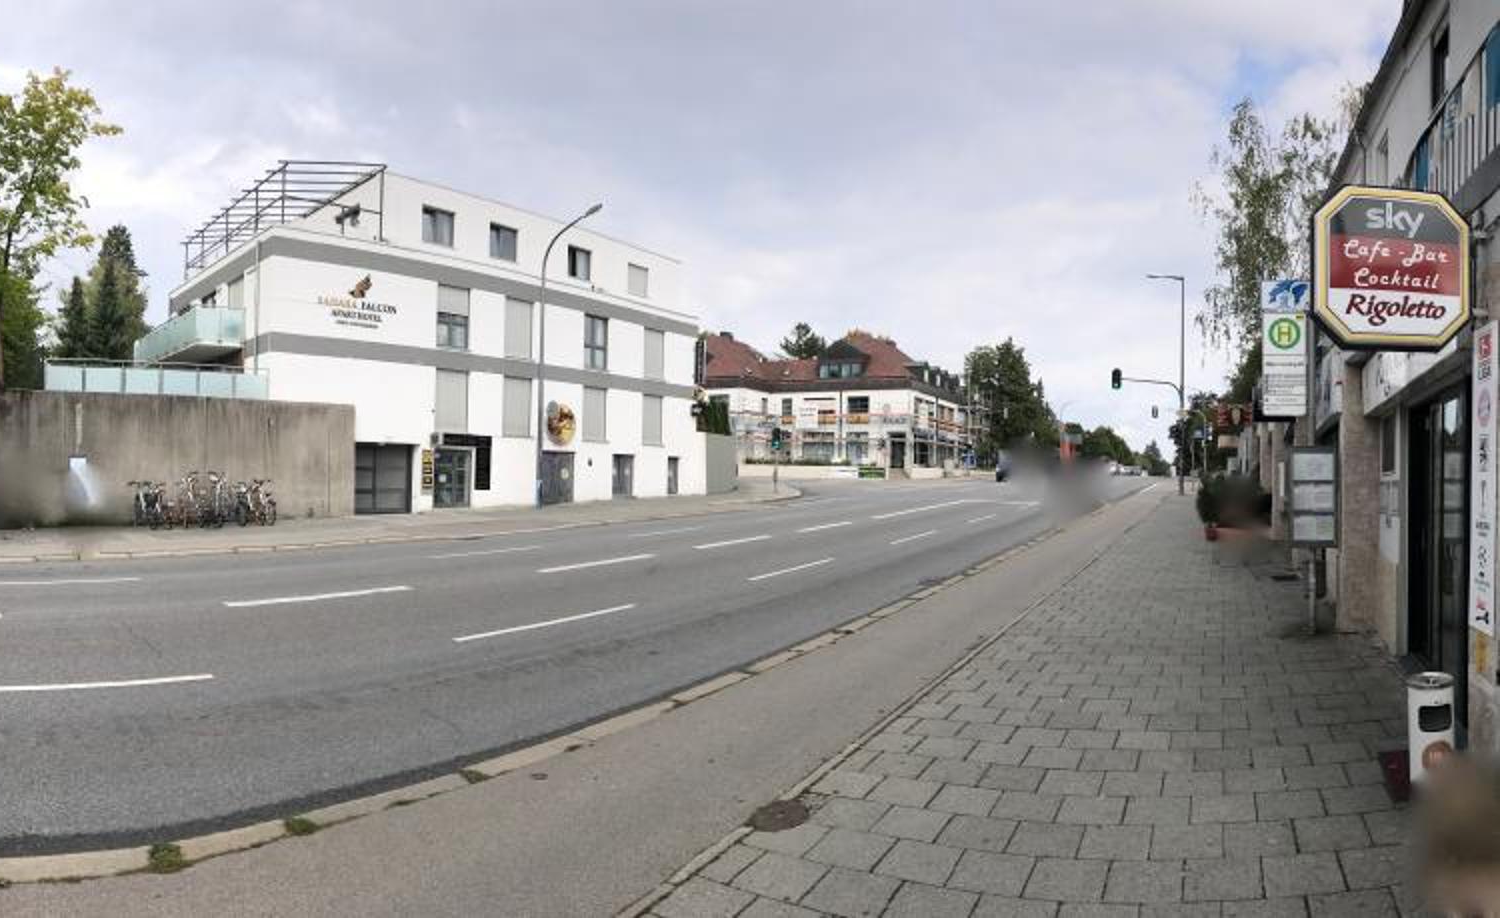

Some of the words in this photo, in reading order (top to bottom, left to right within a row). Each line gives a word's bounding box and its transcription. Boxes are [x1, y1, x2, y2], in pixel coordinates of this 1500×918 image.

[1366, 202, 1424, 238] sky
[1402, 243, 1449, 267] Bar
[1354, 267, 1440, 289] Cocktail
[360, 300, 397, 315] FALCON
[1345, 293, 1446, 326] Rigoletto
[1277, 325, 1292, 343] H
